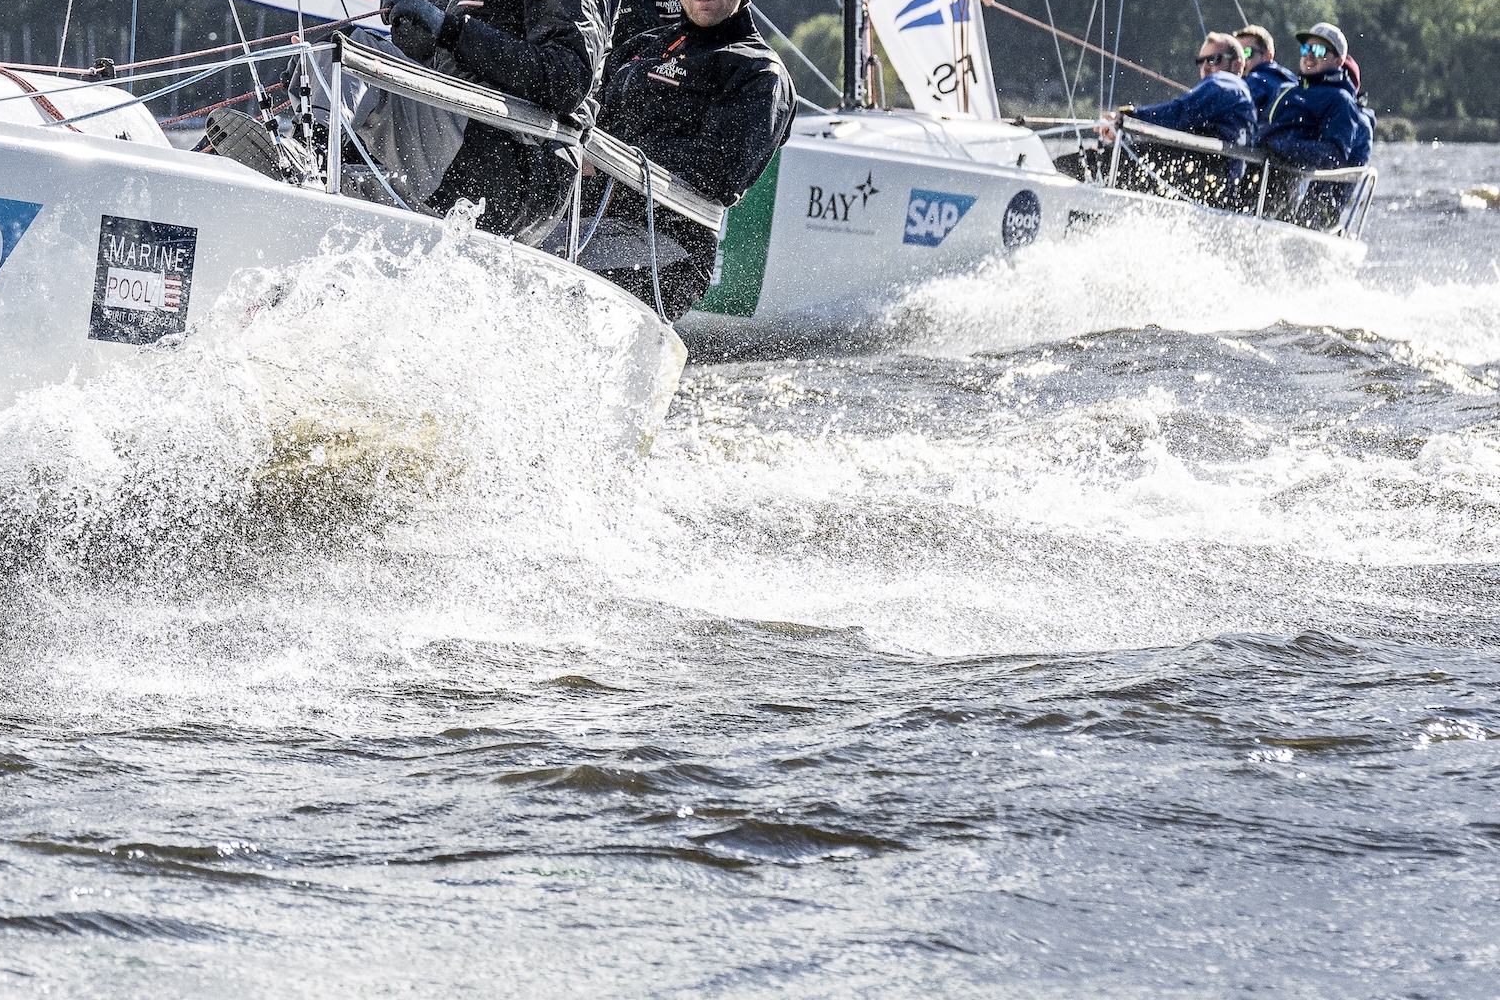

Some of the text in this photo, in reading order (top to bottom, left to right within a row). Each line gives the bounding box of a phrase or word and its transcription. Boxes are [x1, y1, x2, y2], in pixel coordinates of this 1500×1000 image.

[806, 185, 858, 222] BAY
[906, 199, 959, 239] SAP
[109, 234, 187, 272] MARINE
[107, 276, 151, 304] POOL
